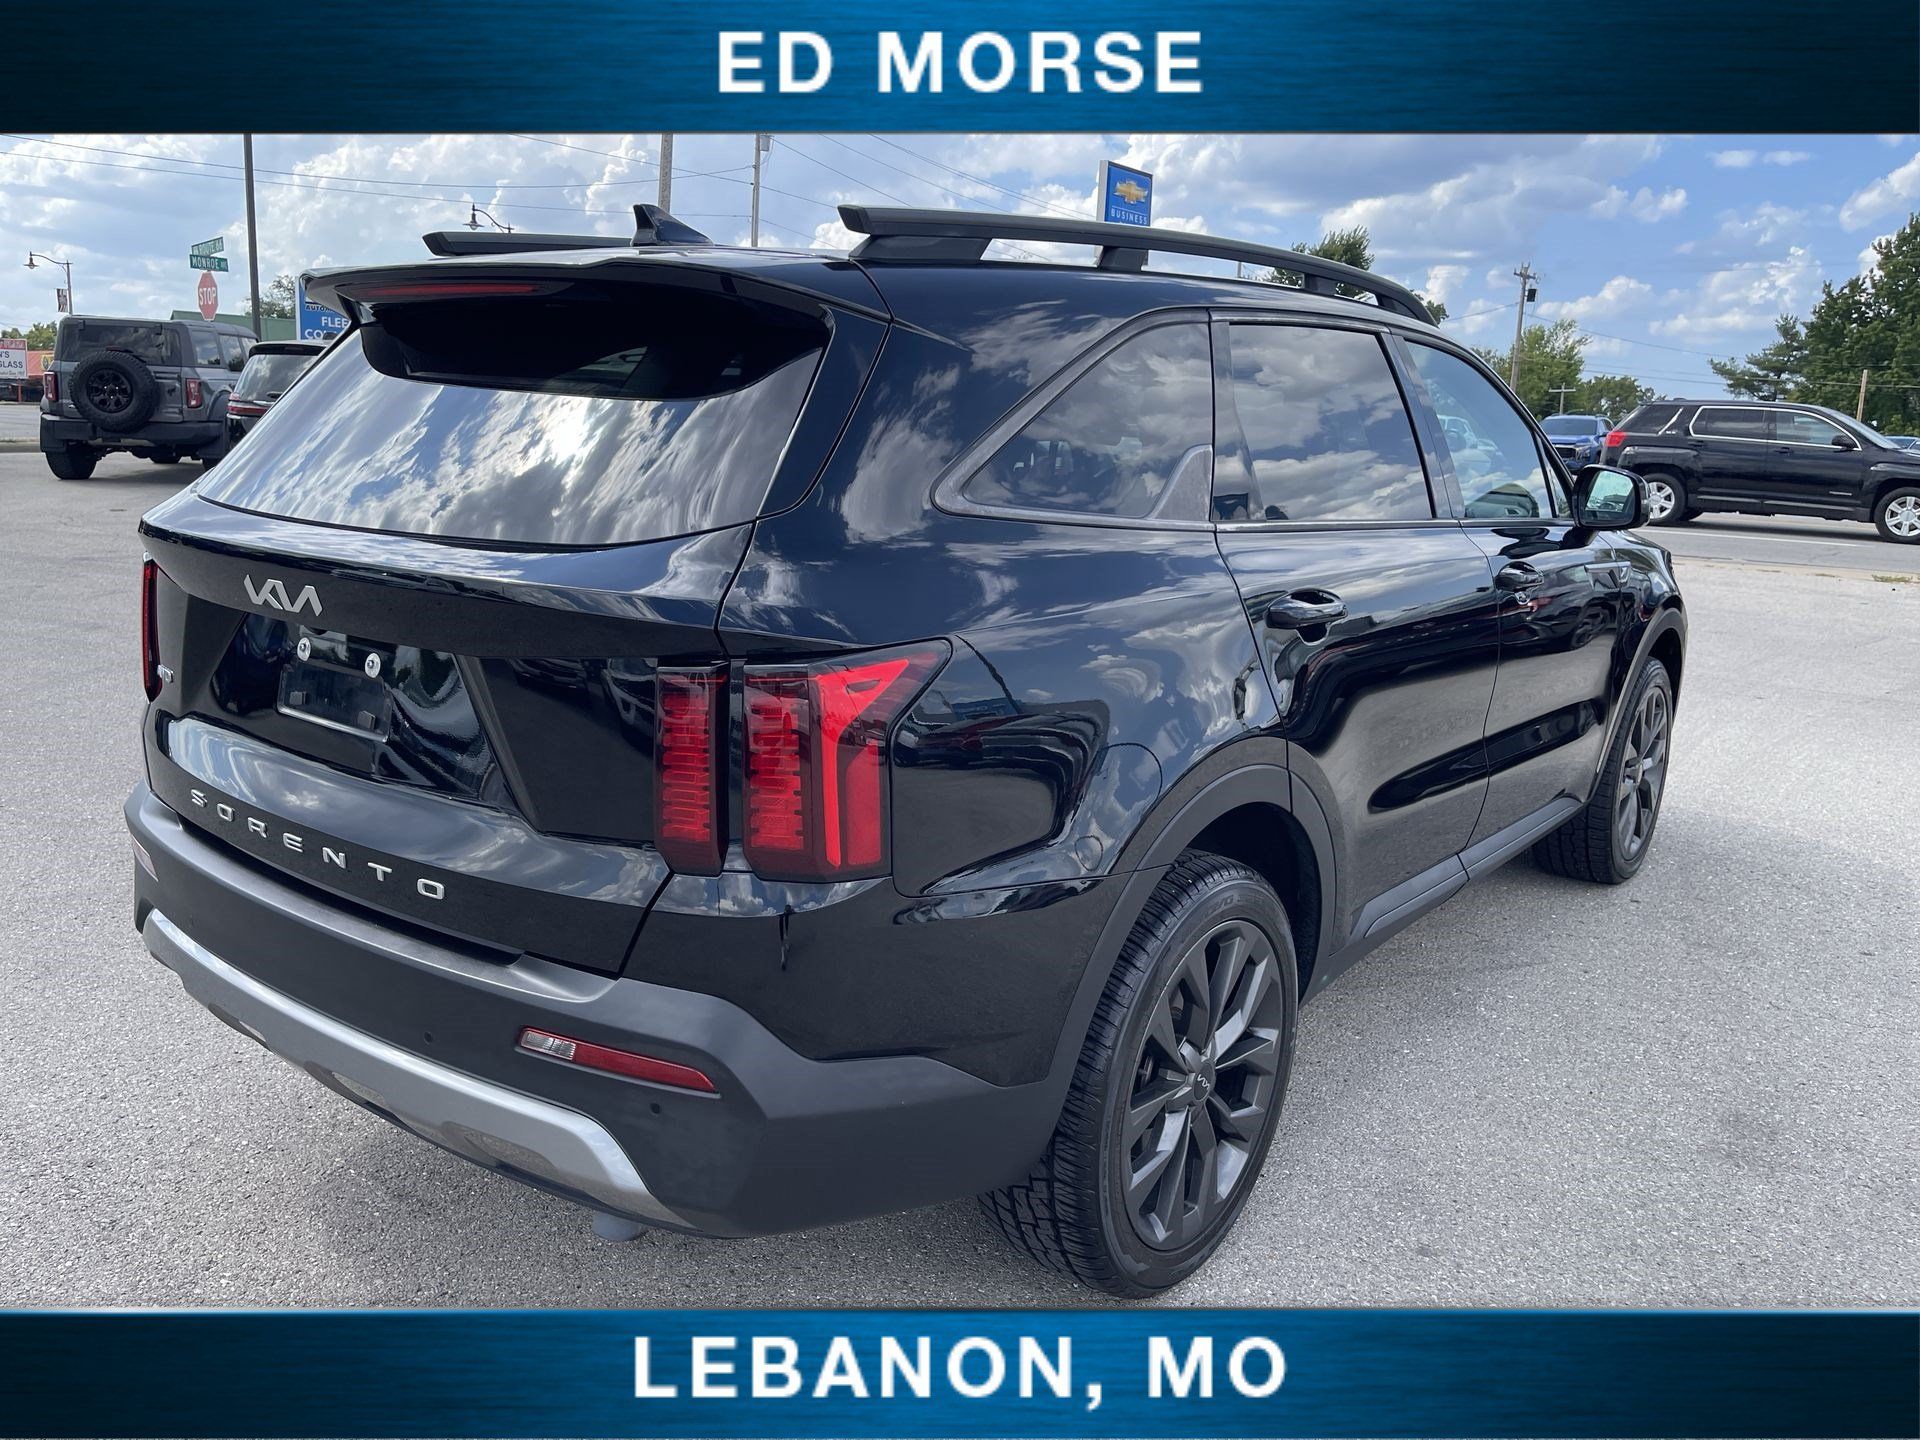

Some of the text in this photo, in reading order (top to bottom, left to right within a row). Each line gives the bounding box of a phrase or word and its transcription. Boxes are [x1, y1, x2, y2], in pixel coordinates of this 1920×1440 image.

[1111, 208, 1147, 225] BUSINESS
[192, 256, 219, 269] MONROE
[199, 287, 216, 305] STOP
[243, 574, 323, 617] KIA
[190, 788, 446, 900] SORENTO
